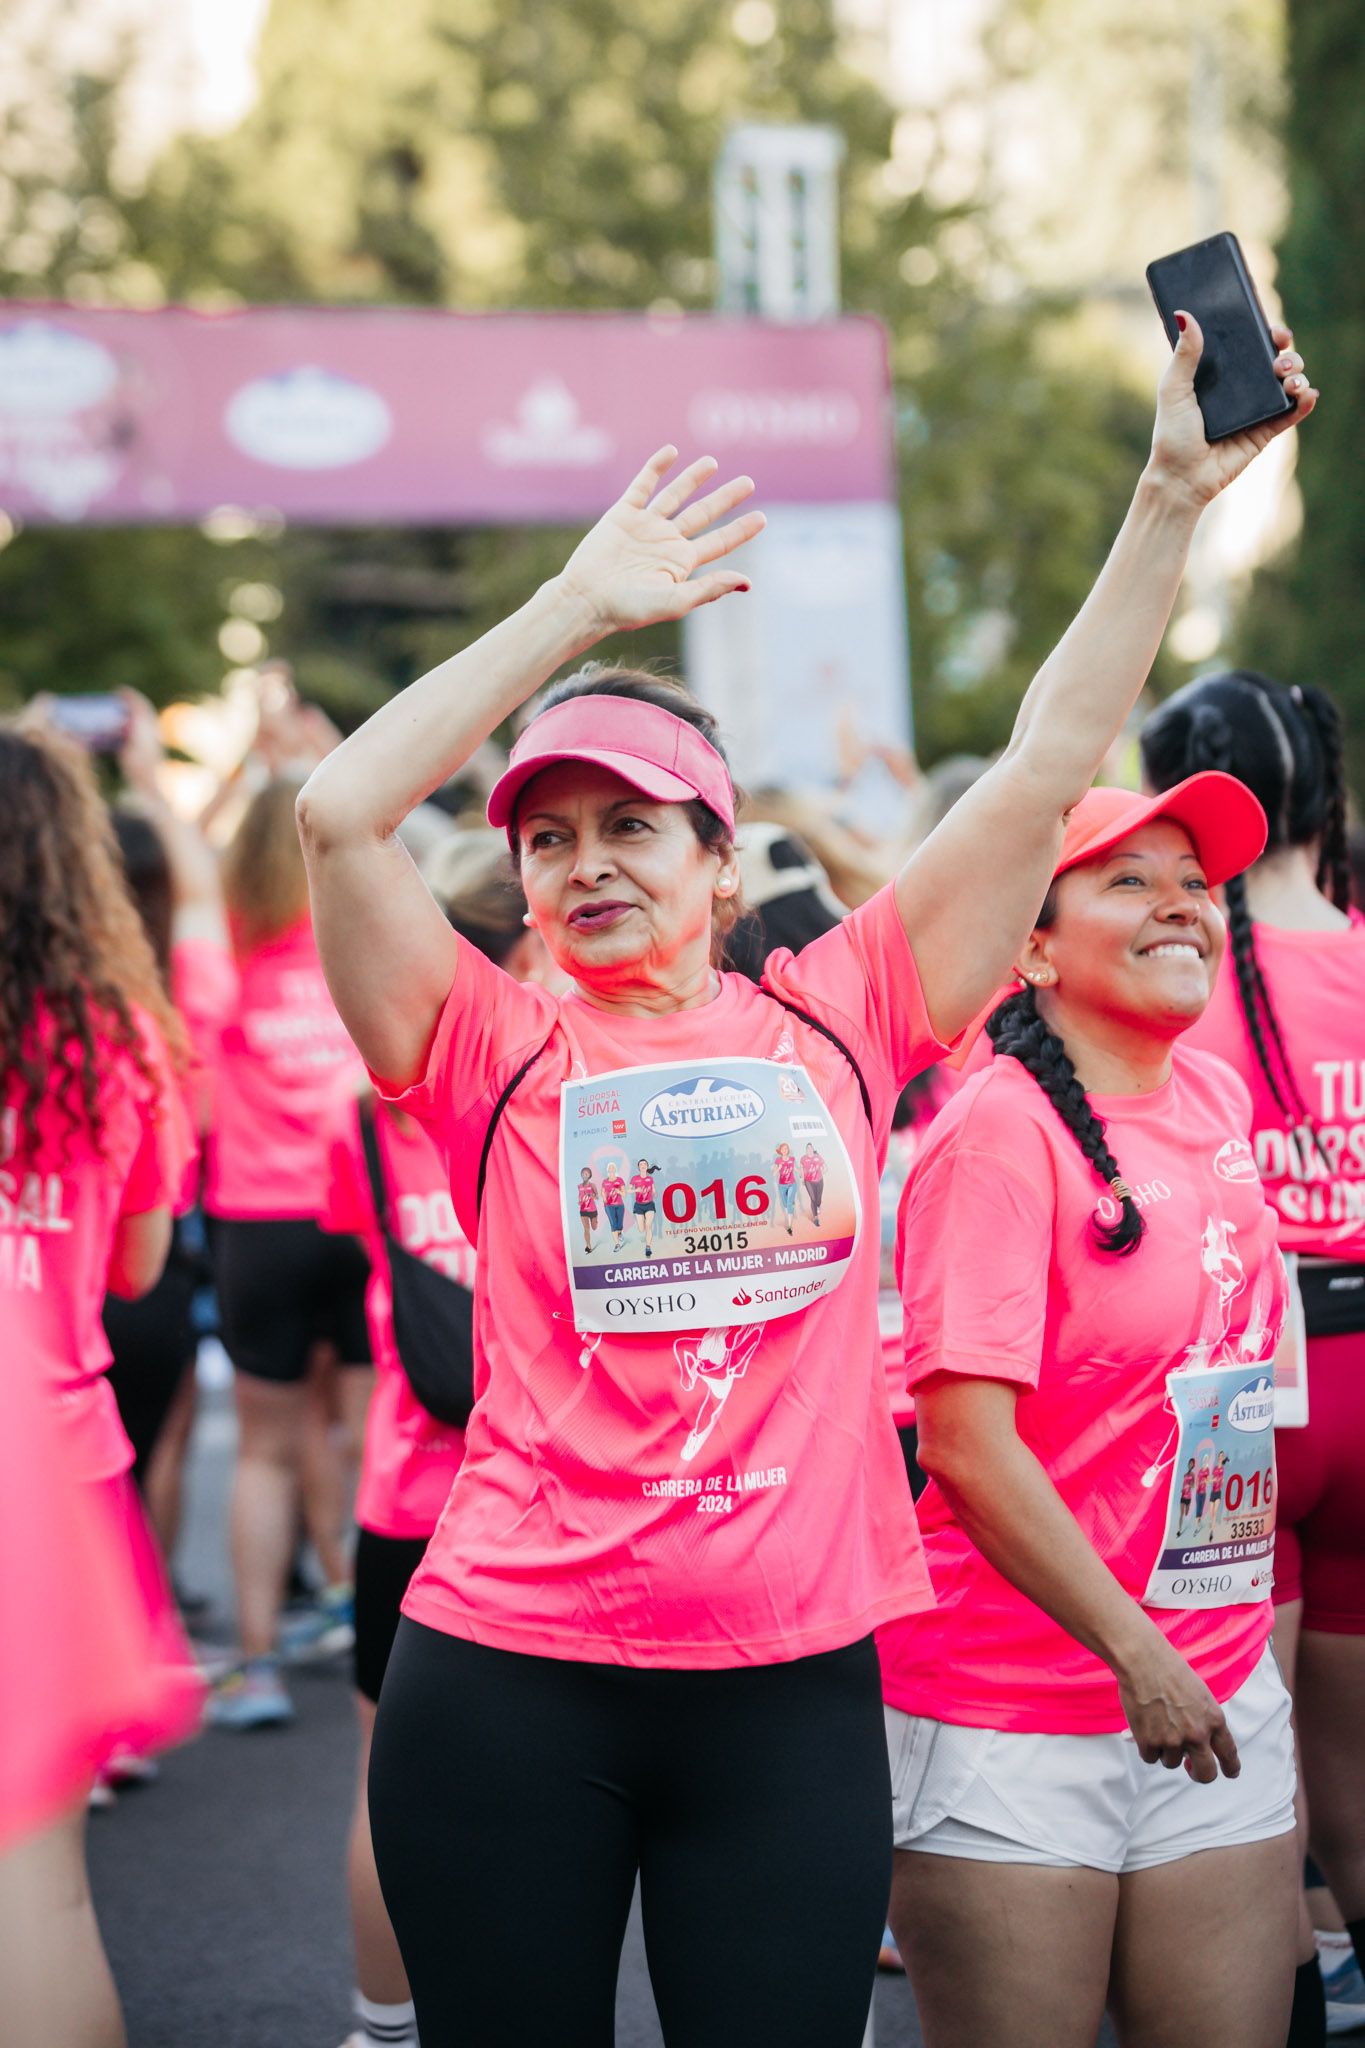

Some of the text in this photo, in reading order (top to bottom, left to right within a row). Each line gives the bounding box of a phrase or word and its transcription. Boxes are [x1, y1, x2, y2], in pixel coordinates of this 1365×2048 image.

[577, 1099, 620, 1119] SUMA
[651, 1102, 758, 1127] ASTURIANA
[581, 1127, 608, 1136] MADRID
[662, 1175, 769, 1223] 016
[1097, 1179, 1172, 1219] OSHO
[684, 1232, 748, 1254] 34015
[604, 1247, 828, 1283] CARRERA DE LA MUJER MADRID
[755, 1279, 827, 1304] Santander
[605, 1292, 696, 1317] OYSHO
[642, 1466, 787, 1497] CARRERA DE LA MUJER
[1225, 1467, 1273, 1511] 016
[697, 1495, 732, 1513] 2024
[1181, 1548, 1221, 1565] CARRERA
[1222, 1546, 1232, 1560] DE
[1233, 1544, 1244, 1558] LA
[1171, 1575, 1232, 1595] OYSHO
